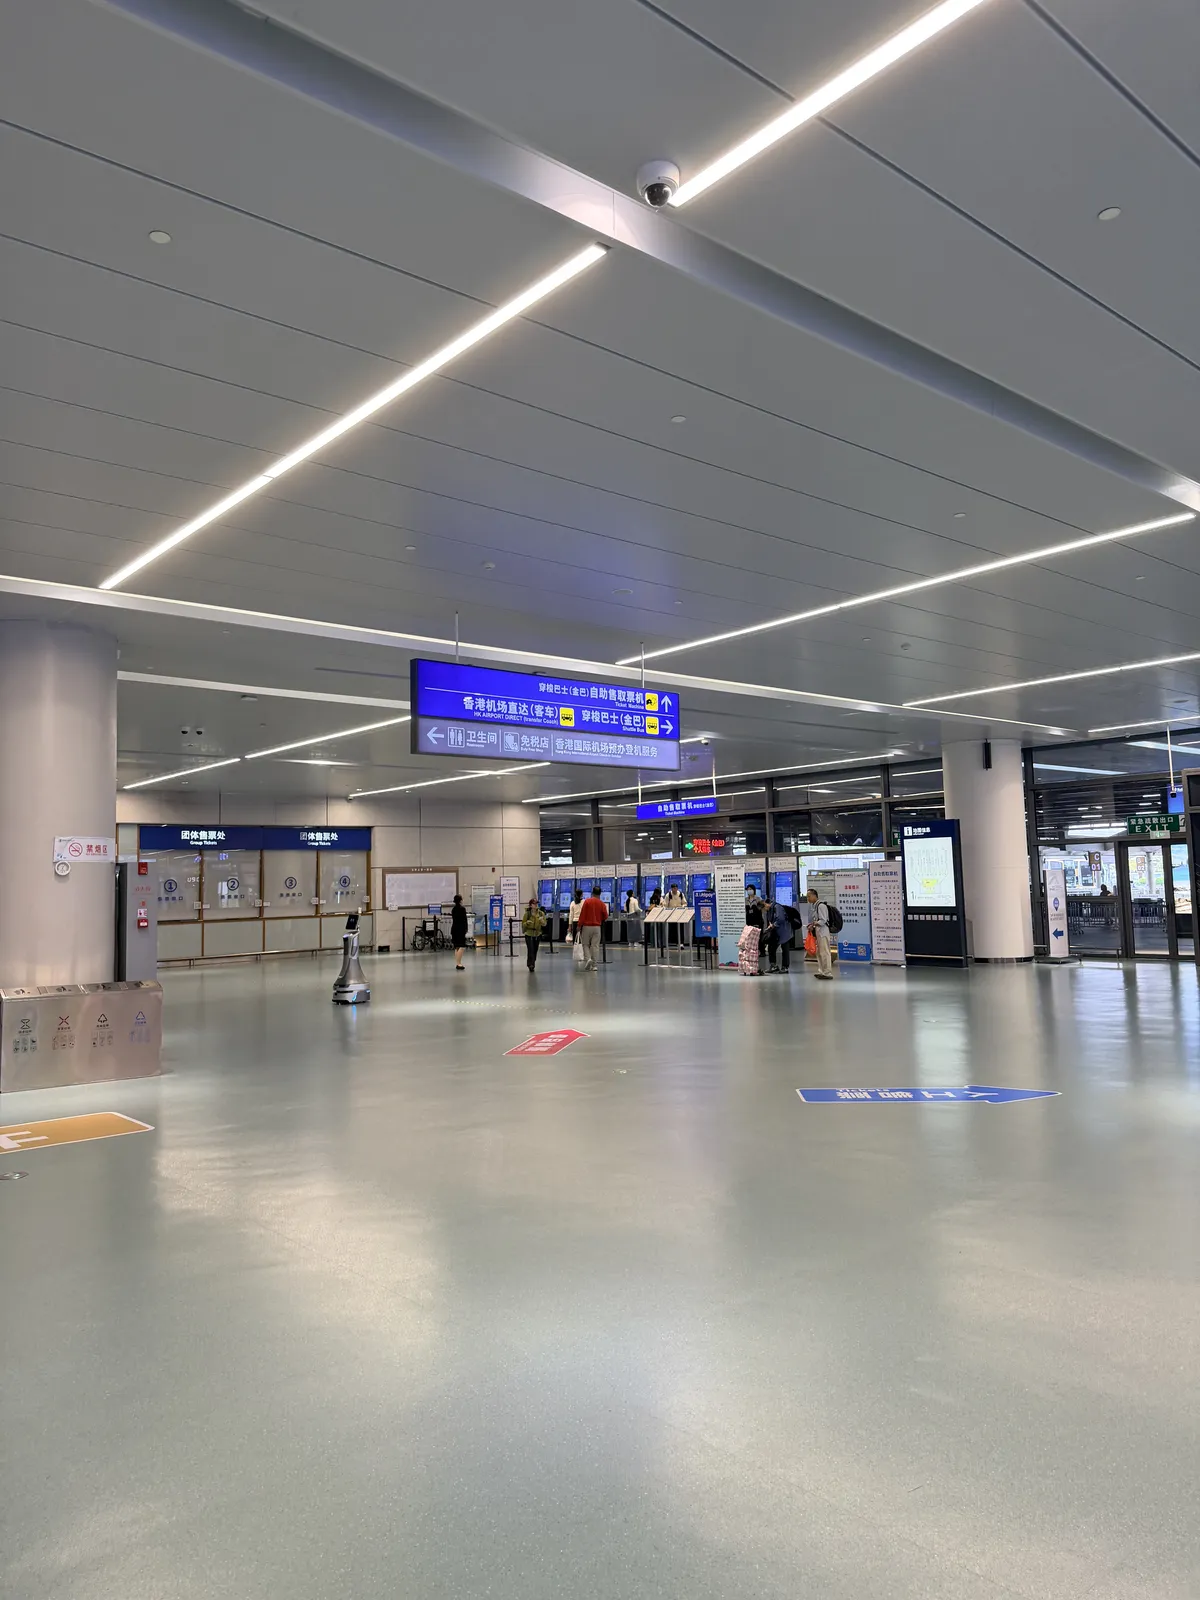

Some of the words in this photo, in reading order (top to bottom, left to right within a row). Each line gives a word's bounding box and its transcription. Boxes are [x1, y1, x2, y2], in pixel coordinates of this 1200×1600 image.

[463, 696, 559, 719] 香港机场直达(客车)
[581, 709, 645, 727] 穿梭巴士(金巴)
[466, 730, 497, 745] 卫生间
[520, 734, 549, 748] 免税店
[1135, 824, 1169, 833] EXIT
[181, 830, 226, 840] 团体售票处
[300, 831, 339, 841] 团体售票处
[86, 844, 108, 854] 禁烟区
[1094, 853, 1100, 861] C
[1091, 863, 1101, 871] 01
